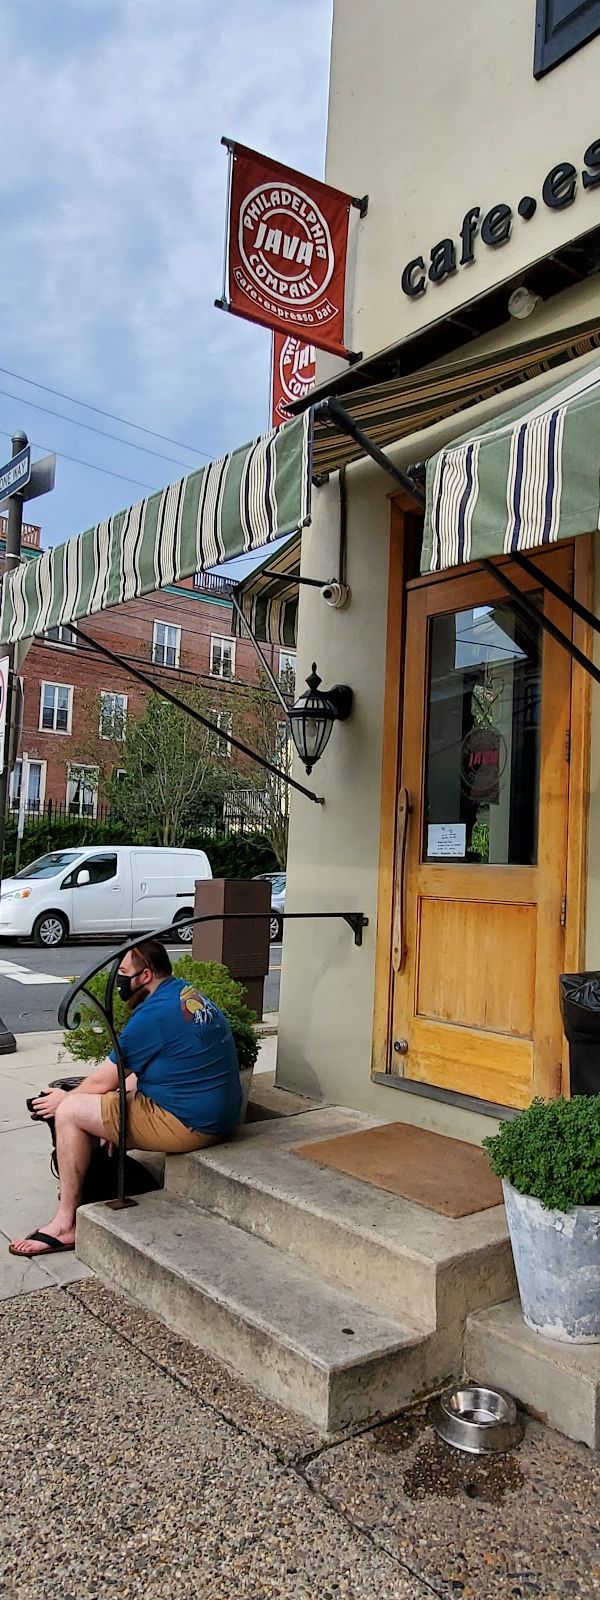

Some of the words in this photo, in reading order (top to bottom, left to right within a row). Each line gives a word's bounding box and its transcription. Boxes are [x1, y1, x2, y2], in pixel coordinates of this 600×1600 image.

[243, 190, 326, 259] PHILADELPHIA
[253, 222, 314, 267] JAVA
[249, 254, 318, 298] COMPANY
[317, 304, 332, 321] bar
[12, 460, 26, 481] WAY
